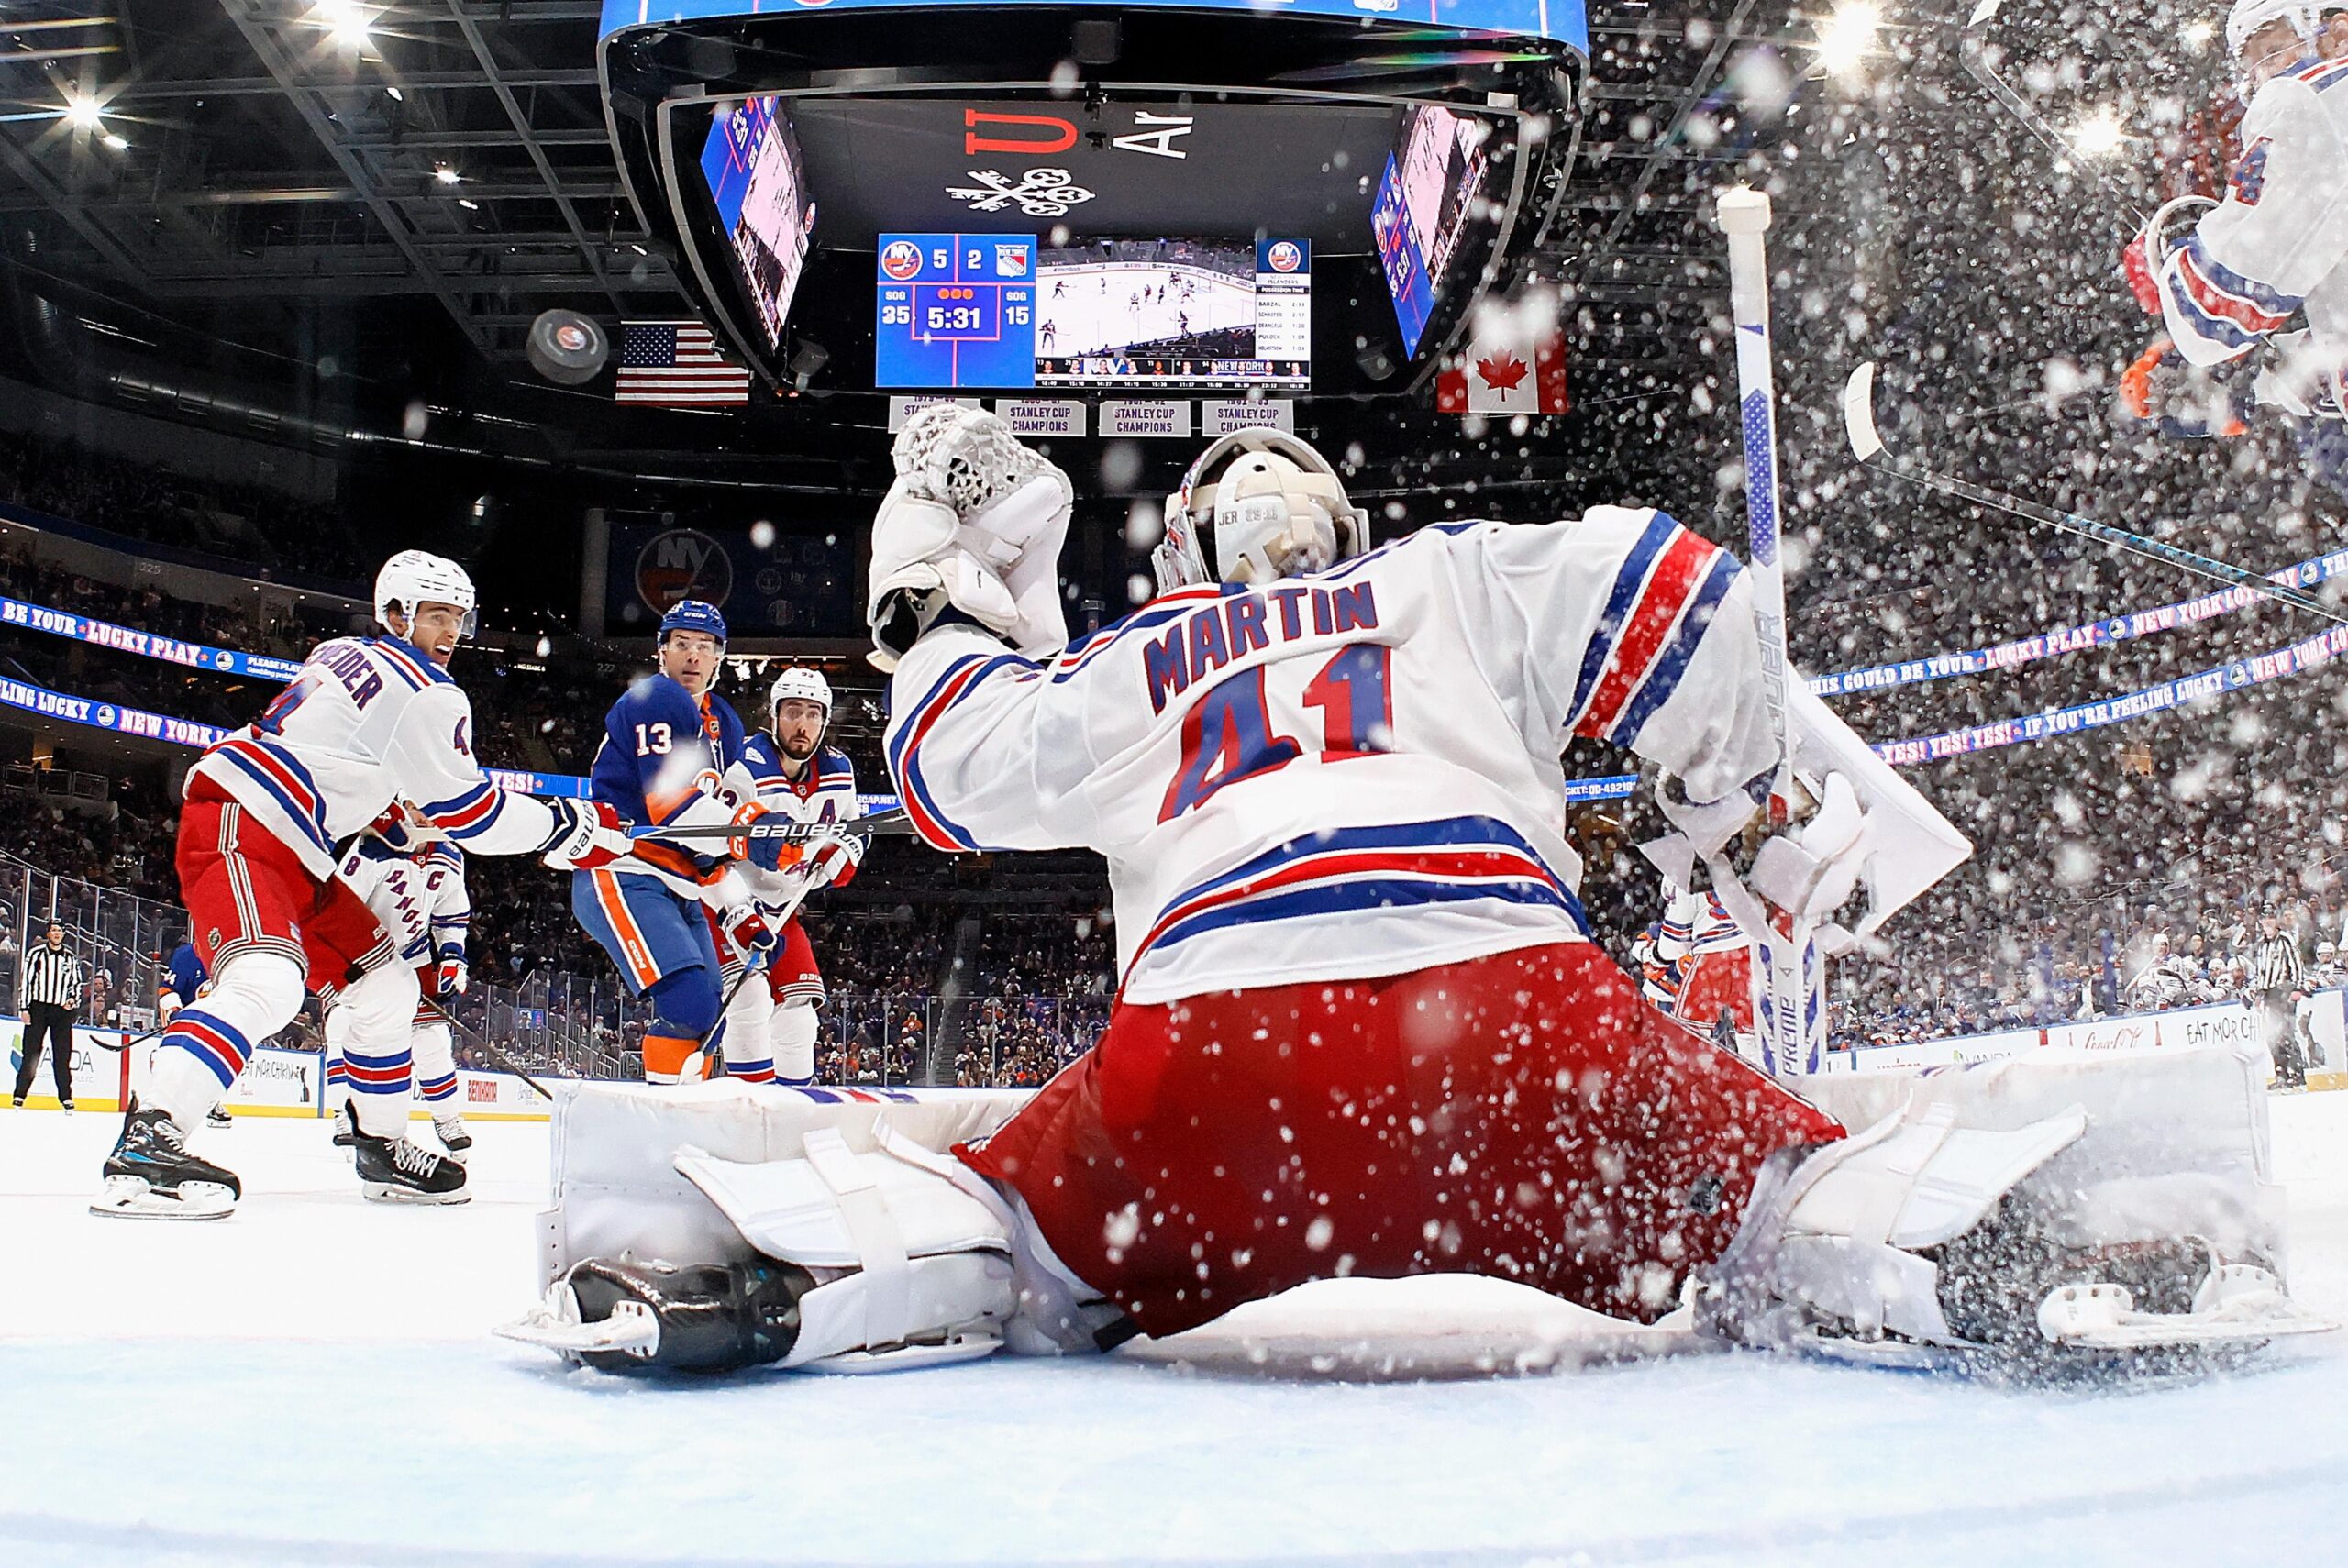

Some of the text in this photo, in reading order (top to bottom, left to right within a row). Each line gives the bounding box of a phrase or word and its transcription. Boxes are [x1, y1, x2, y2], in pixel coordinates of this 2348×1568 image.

[933, 249, 947, 269] 5
[968, 250, 982, 269] 2
[885, 291, 906, 300] SOG
[1006, 292, 1026, 301] SOG
[882, 306, 910, 325] 35
[927, 307, 980, 329] 5:31
[1005, 306, 1029, 325] 15
[1010, 407, 1071, 418] STANLEY CUP
[1114, 408, 1175, 419] STANLEY CUP
[1218, 408, 1279, 419] STANLEY CUP
[1012, 421, 1069, 432] CHAMPIONS
[1116, 422, 1173, 433] CHAMPIONS
[1219, 511, 1238, 526] JER
[2131, 608, 2176, 635] NEW
[2176, 600, 2223, 623] YORK
[3, 601, 201, 667] BE YOUR LUCKY PLAY
[1143, 581, 1378, 717] MARTIN
[1844, 668, 1896, 690] COULD
[1900, 662, 1924, 681] BE
[1926, 656, 1975, 677] YOUR
[1985, 639, 2043, 669] LUCKY
[2046, 624, 2097, 655] PLAY
[2251, 650, 2292, 682] NEW
[2293, 635, 2330, 669] YORK
[247, 657, 280, 670] PLEASE
[0, 679, 91, 721] LING LUCKY
[119, 708, 163, 737] NEW
[165, 719, 212, 746] YORK
[1881, 671, 2223, 765] YES! YES! YES! IF YOU'RE FEELING LUCKY
[636, 723, 672, 757] 13
[1157, 643, 1394, 825] 41
[489, 771, 534, 793] YES!
[817, 799, 836, 823] A
[749, 823, 847, 838] BAUER
[343, 856, 360, 877] 8
[426, 871, 446, 891] C
[385, 870, 425, 939] RANGE
[2187, 1021, 2209, 1045] EAT
[2213, 1017, 2239, 1044] MOR
